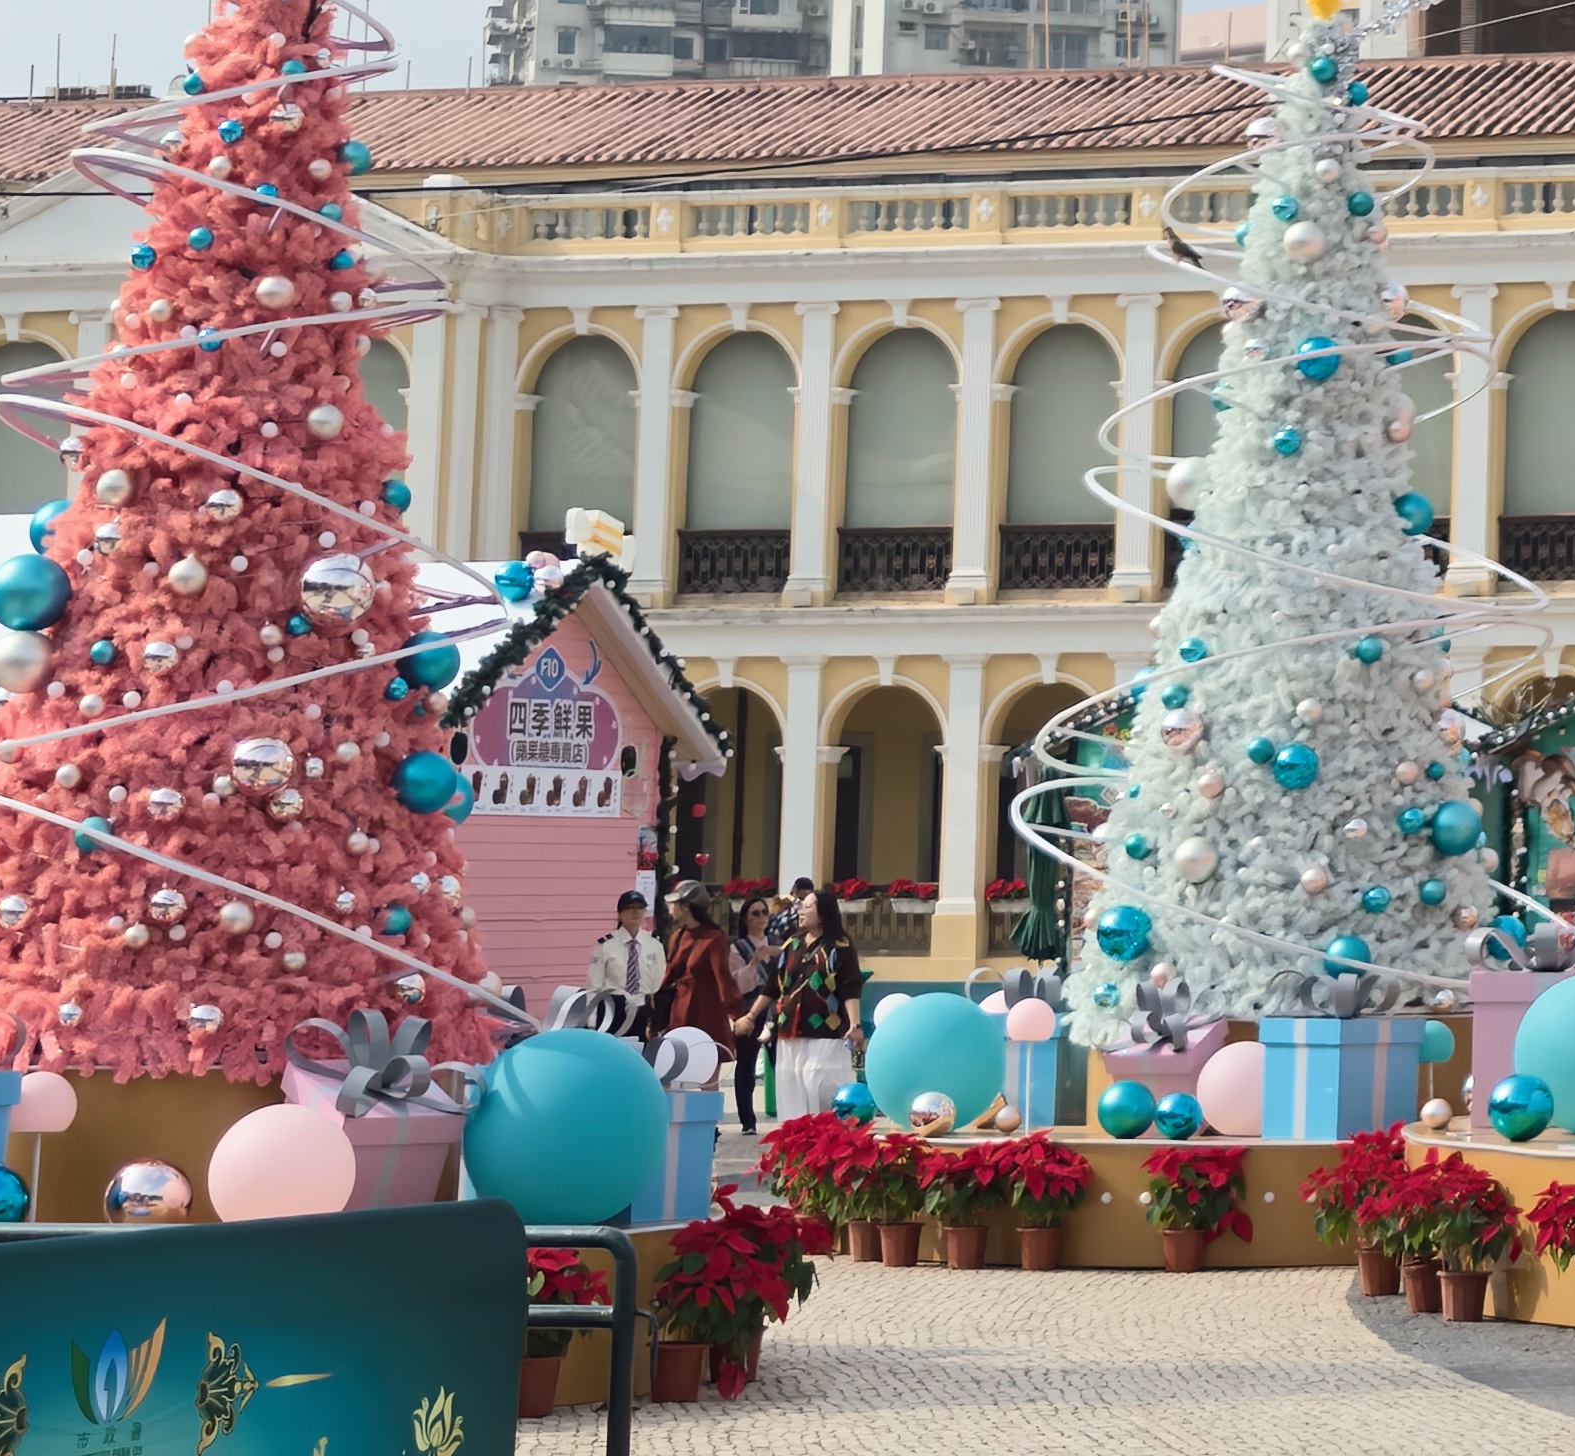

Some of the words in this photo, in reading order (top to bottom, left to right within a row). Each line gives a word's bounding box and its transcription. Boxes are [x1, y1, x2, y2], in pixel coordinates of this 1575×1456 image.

[540, 657, 559, 678] F10
[510, 702, 593, 739] 四季鮮果
